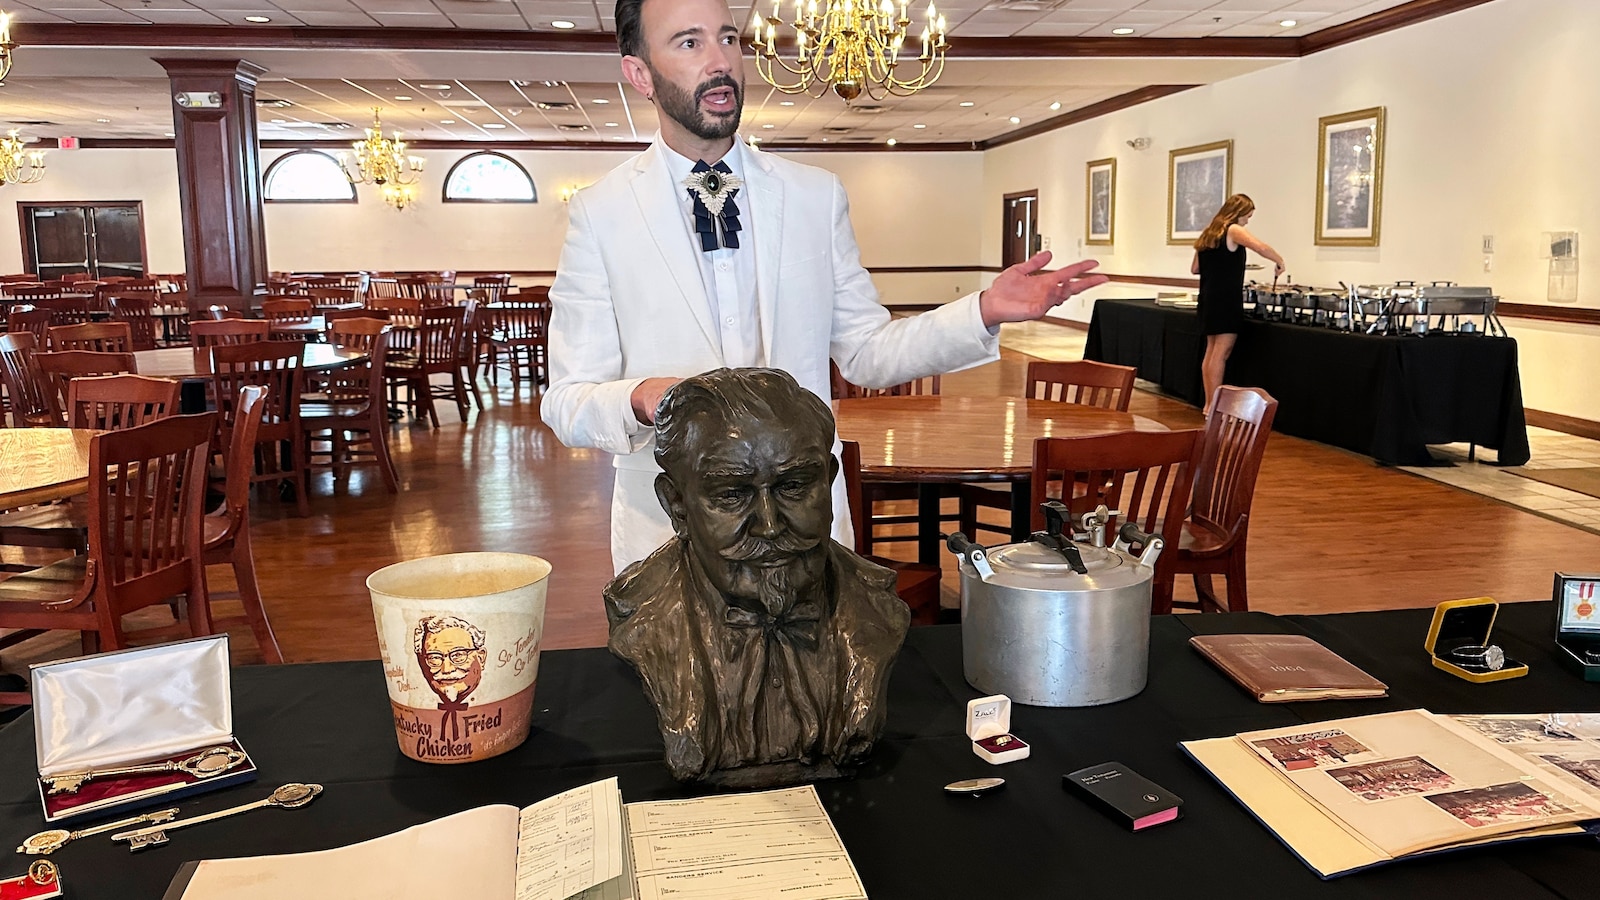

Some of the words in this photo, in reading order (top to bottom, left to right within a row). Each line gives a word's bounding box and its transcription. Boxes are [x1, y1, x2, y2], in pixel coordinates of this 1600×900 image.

[497, 649, 513, 668] So
[513, 627, 535, 657] Tender
[514, 658, 526, 677] So
[462, 707, 502, 738] Fried
[416, 736, 473, 758] Chicken
